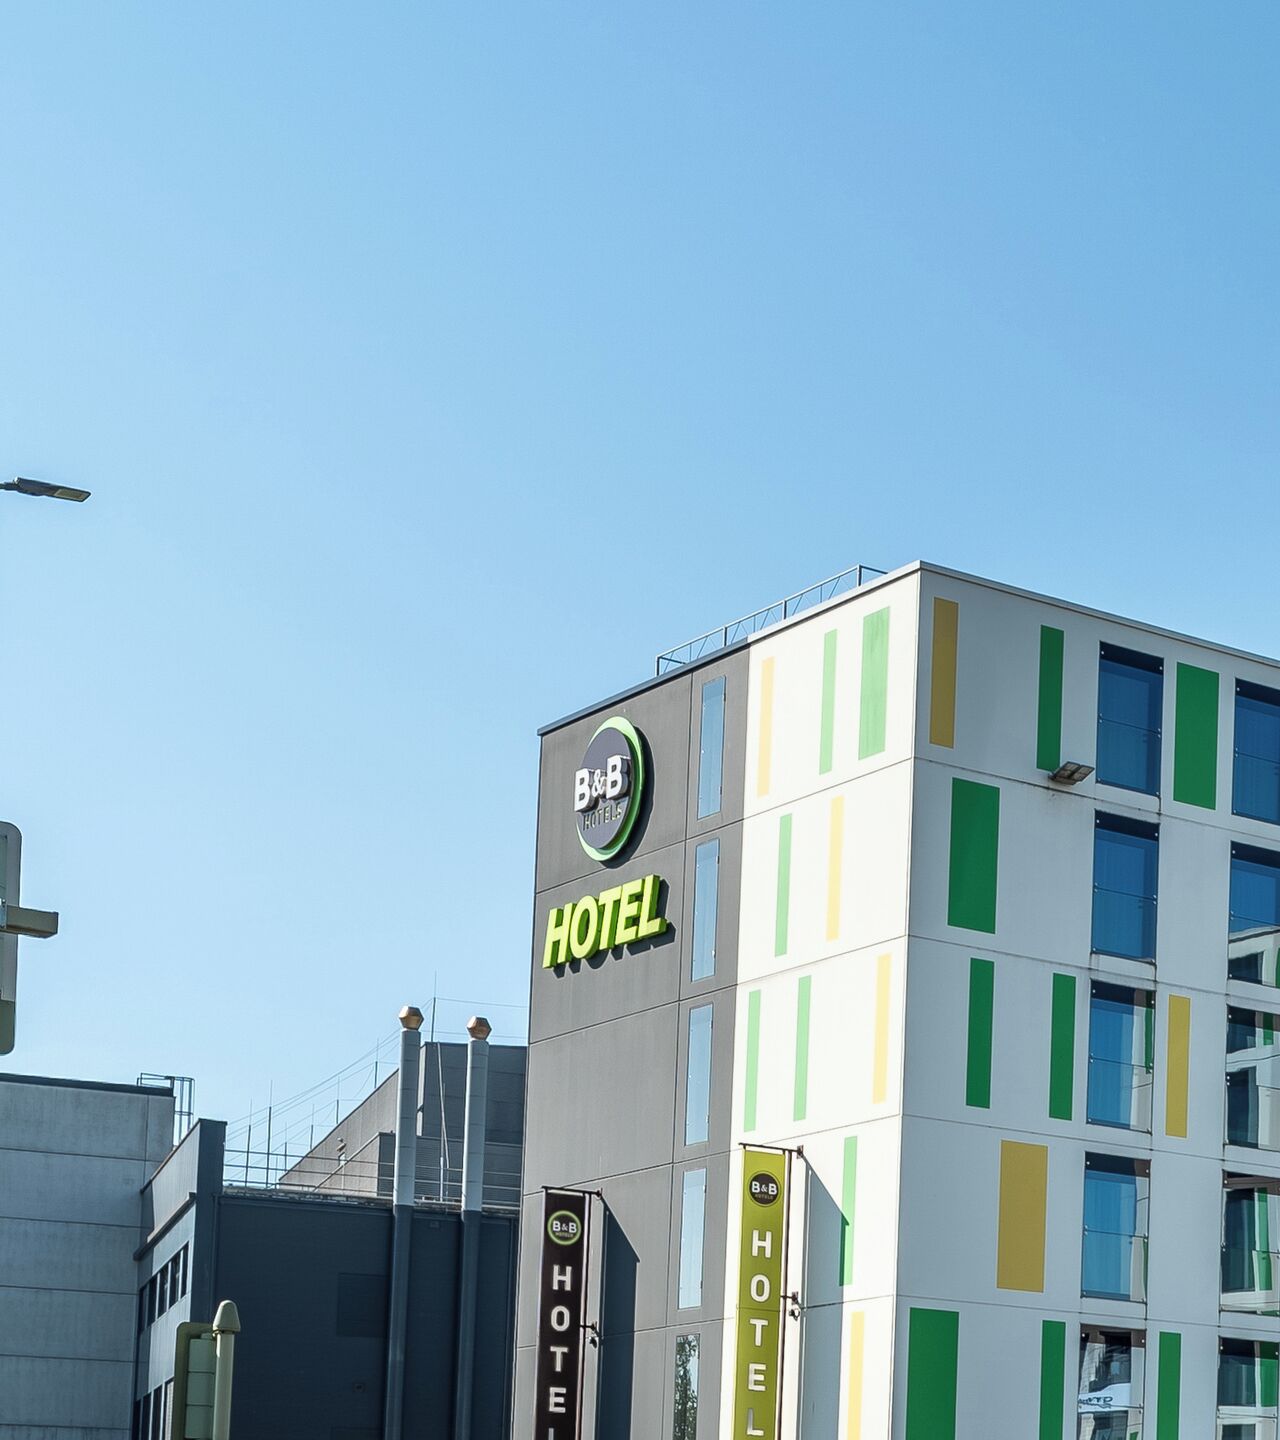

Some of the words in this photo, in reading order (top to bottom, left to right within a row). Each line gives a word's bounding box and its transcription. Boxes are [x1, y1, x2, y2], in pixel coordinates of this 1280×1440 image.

[574, 754, 627, 812] B&B
[583, 802, 623, 831] HOTELS
[542, 874, 668, 968] HOTEL
[751, 1181, 777, 1195] B&B
[552, 1220, 577, 1233] B&B
[746, 1229, 773, 1437] HOTEL
